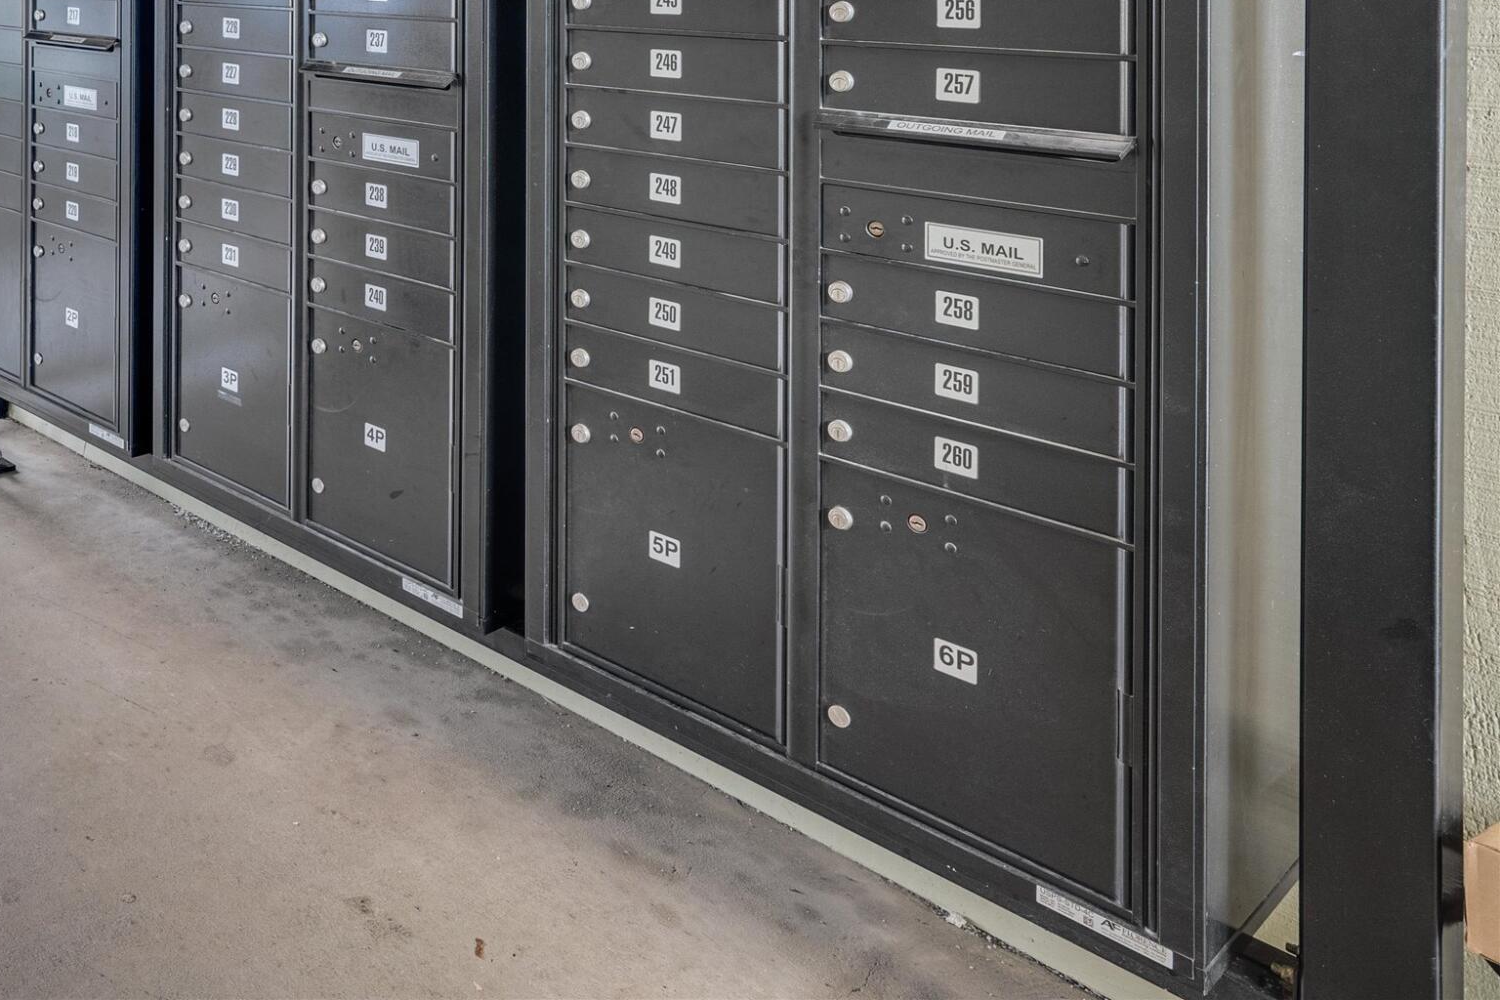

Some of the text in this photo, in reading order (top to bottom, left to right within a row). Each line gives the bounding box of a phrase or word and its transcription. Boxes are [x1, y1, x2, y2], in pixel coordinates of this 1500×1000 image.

[945, 0, 975, 20] 256
[370, 32, 385, 47] 237
[225, 65, 237, 79] 227
[656, 53, 677, 71] 246
[944, 73, 974, 95] 257
[656, 114, 677, 134] 247
[896, 122, 996, 138] OUTGOING MAIL
[371, 142, 410, 156] U.S. MAIL
[369, 185, 384, 202] 238
[655, 177, 677, 197] 248
[369, 237, 384, 254] 239
[655, 240, 676, 260] 249
[943, 236, 1024, 260] U.S. MAIL
[369, 287, 384, 305] 240
[67, 310, 77, 323] 2P
[655, 302, 676, 323] 250
[943, 296, 973, 321] 258
[223, 371, 236, 385] 3P
[655, 364, 674, 386] 251
[943, 369, 972, 395] 259
[367, 427, 384, 443] 4P
[942, 443, 972, 470] 260
[653, 536, 678, 557] 5P
[939, 645, 974, 670] 6P
